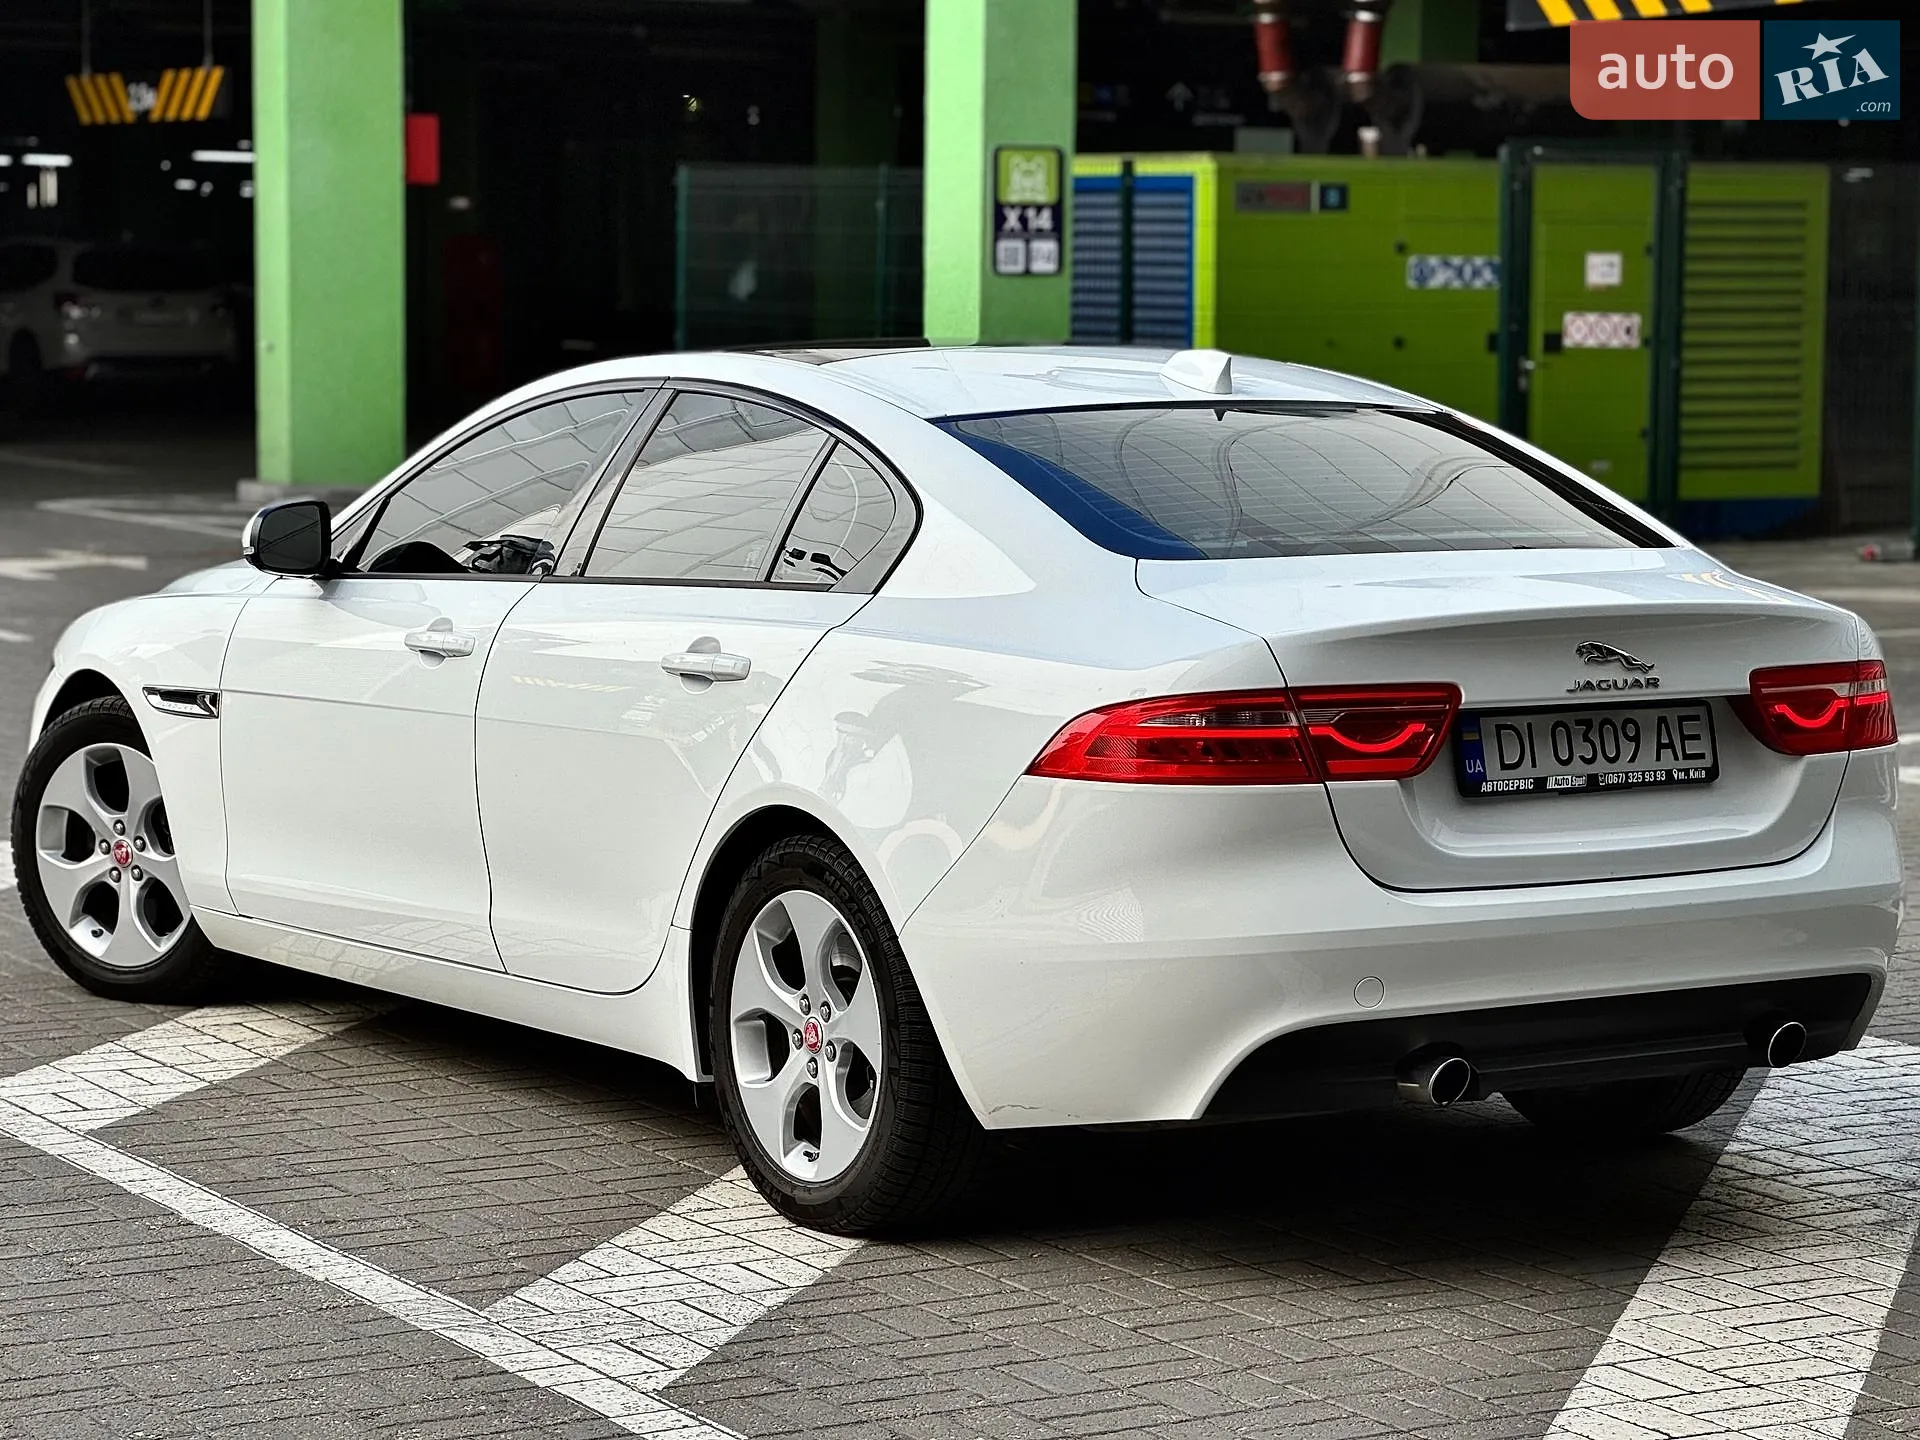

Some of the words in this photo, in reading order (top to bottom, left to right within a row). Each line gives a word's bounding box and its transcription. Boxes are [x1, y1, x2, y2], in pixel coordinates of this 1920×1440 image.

[1003, 206, 1023, 231] X
[1024, 206, 1053, 231] 14
[1566, 676, 1660, 693] JAGUAR
[1494, 721, 1538, 771] DI
[1550, 717, 1641, 766] 0309
[1655, 714, 1706, 762] AE
[1465, 759, 1484, 774] UA
[1689, 769, 1706, 779] Київ
[1605, 772, 1626, 785] (067)
[1627, 772, 1643, 783] 325
[1644, 771, 1655, 782] 93
[1656, 770, 1666, 781] 93
[1480, 779, 1535, 793] АВТОСЕРВІС
